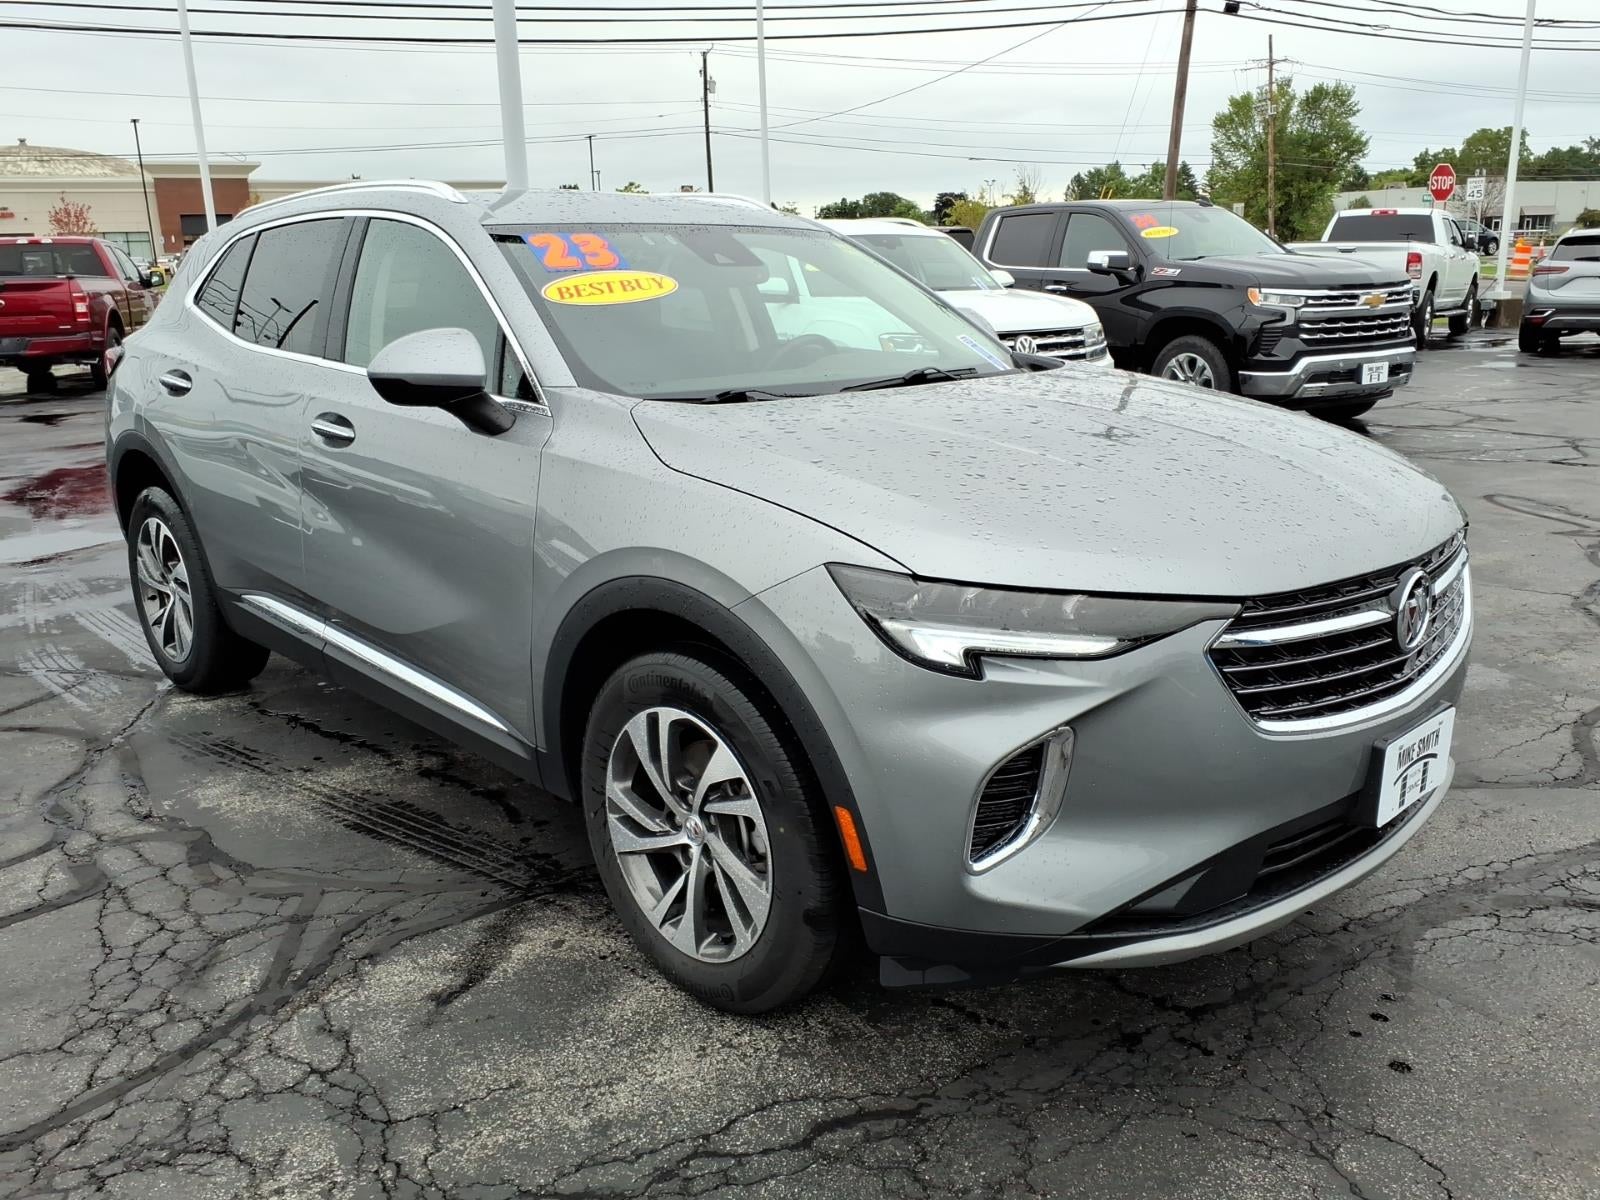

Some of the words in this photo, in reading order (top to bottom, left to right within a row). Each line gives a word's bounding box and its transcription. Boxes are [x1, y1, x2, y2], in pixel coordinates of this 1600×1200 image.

[1431, 175, 1454, 191] STOP
[1467, 189, 1483, 198] 45
[528, 232, 620, 270] 23
[556, 281, 615, 301] BEST
[619, 276, 666, 293] BUY
[628, 669, 697, 698] Continental
[1396, 742, 1417, 771] MIKE
[1416, 727, 1441, 757] SMITH
